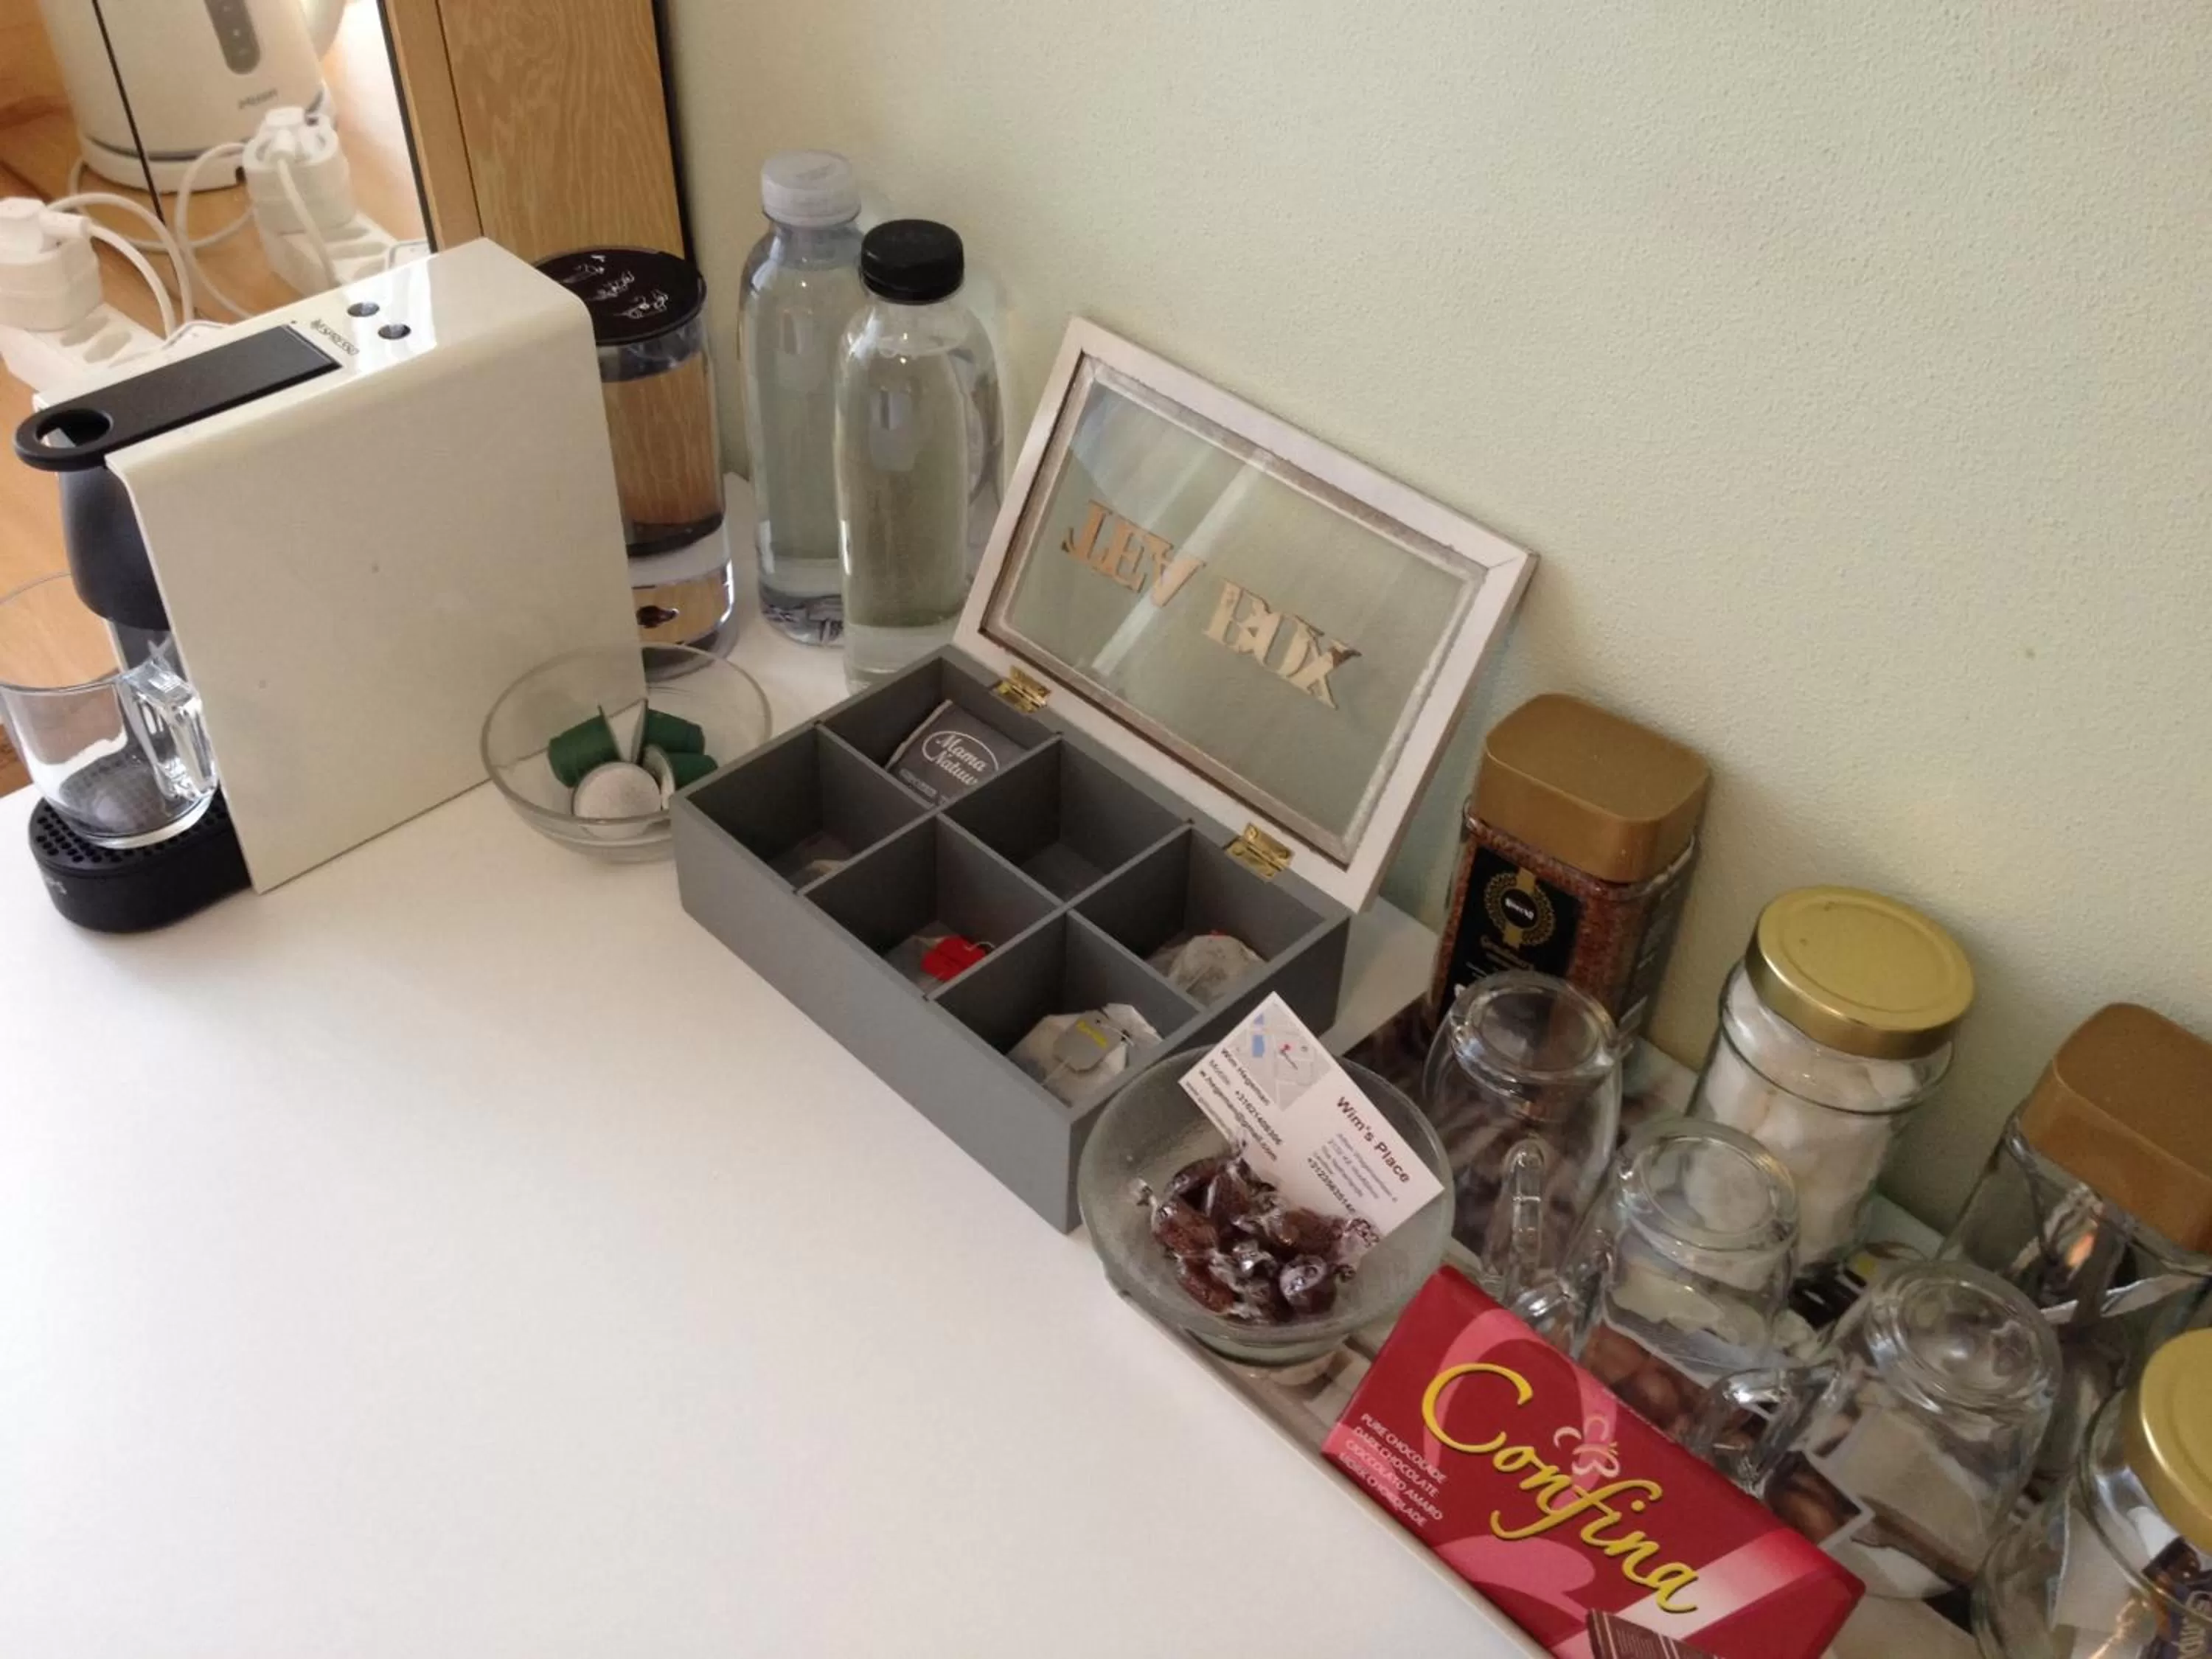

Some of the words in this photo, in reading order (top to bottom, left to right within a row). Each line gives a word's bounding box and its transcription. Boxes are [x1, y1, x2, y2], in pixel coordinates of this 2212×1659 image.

[934, 734, 988, 773] Mama
[1336, 1096, 1374, 1142] Wim's
[1374, 1141, 1410, 1183] Place
[1352, 1426, 1382, 1451] DARK
[1380, 1447, 1439, 1498] CHOCOLATE
[1360, 1413, 1388, 1437] PURE
[1386, 1433, 1447, 1484] CHOCOLADE
[1422, 1362, 1699, 1614] Confina
